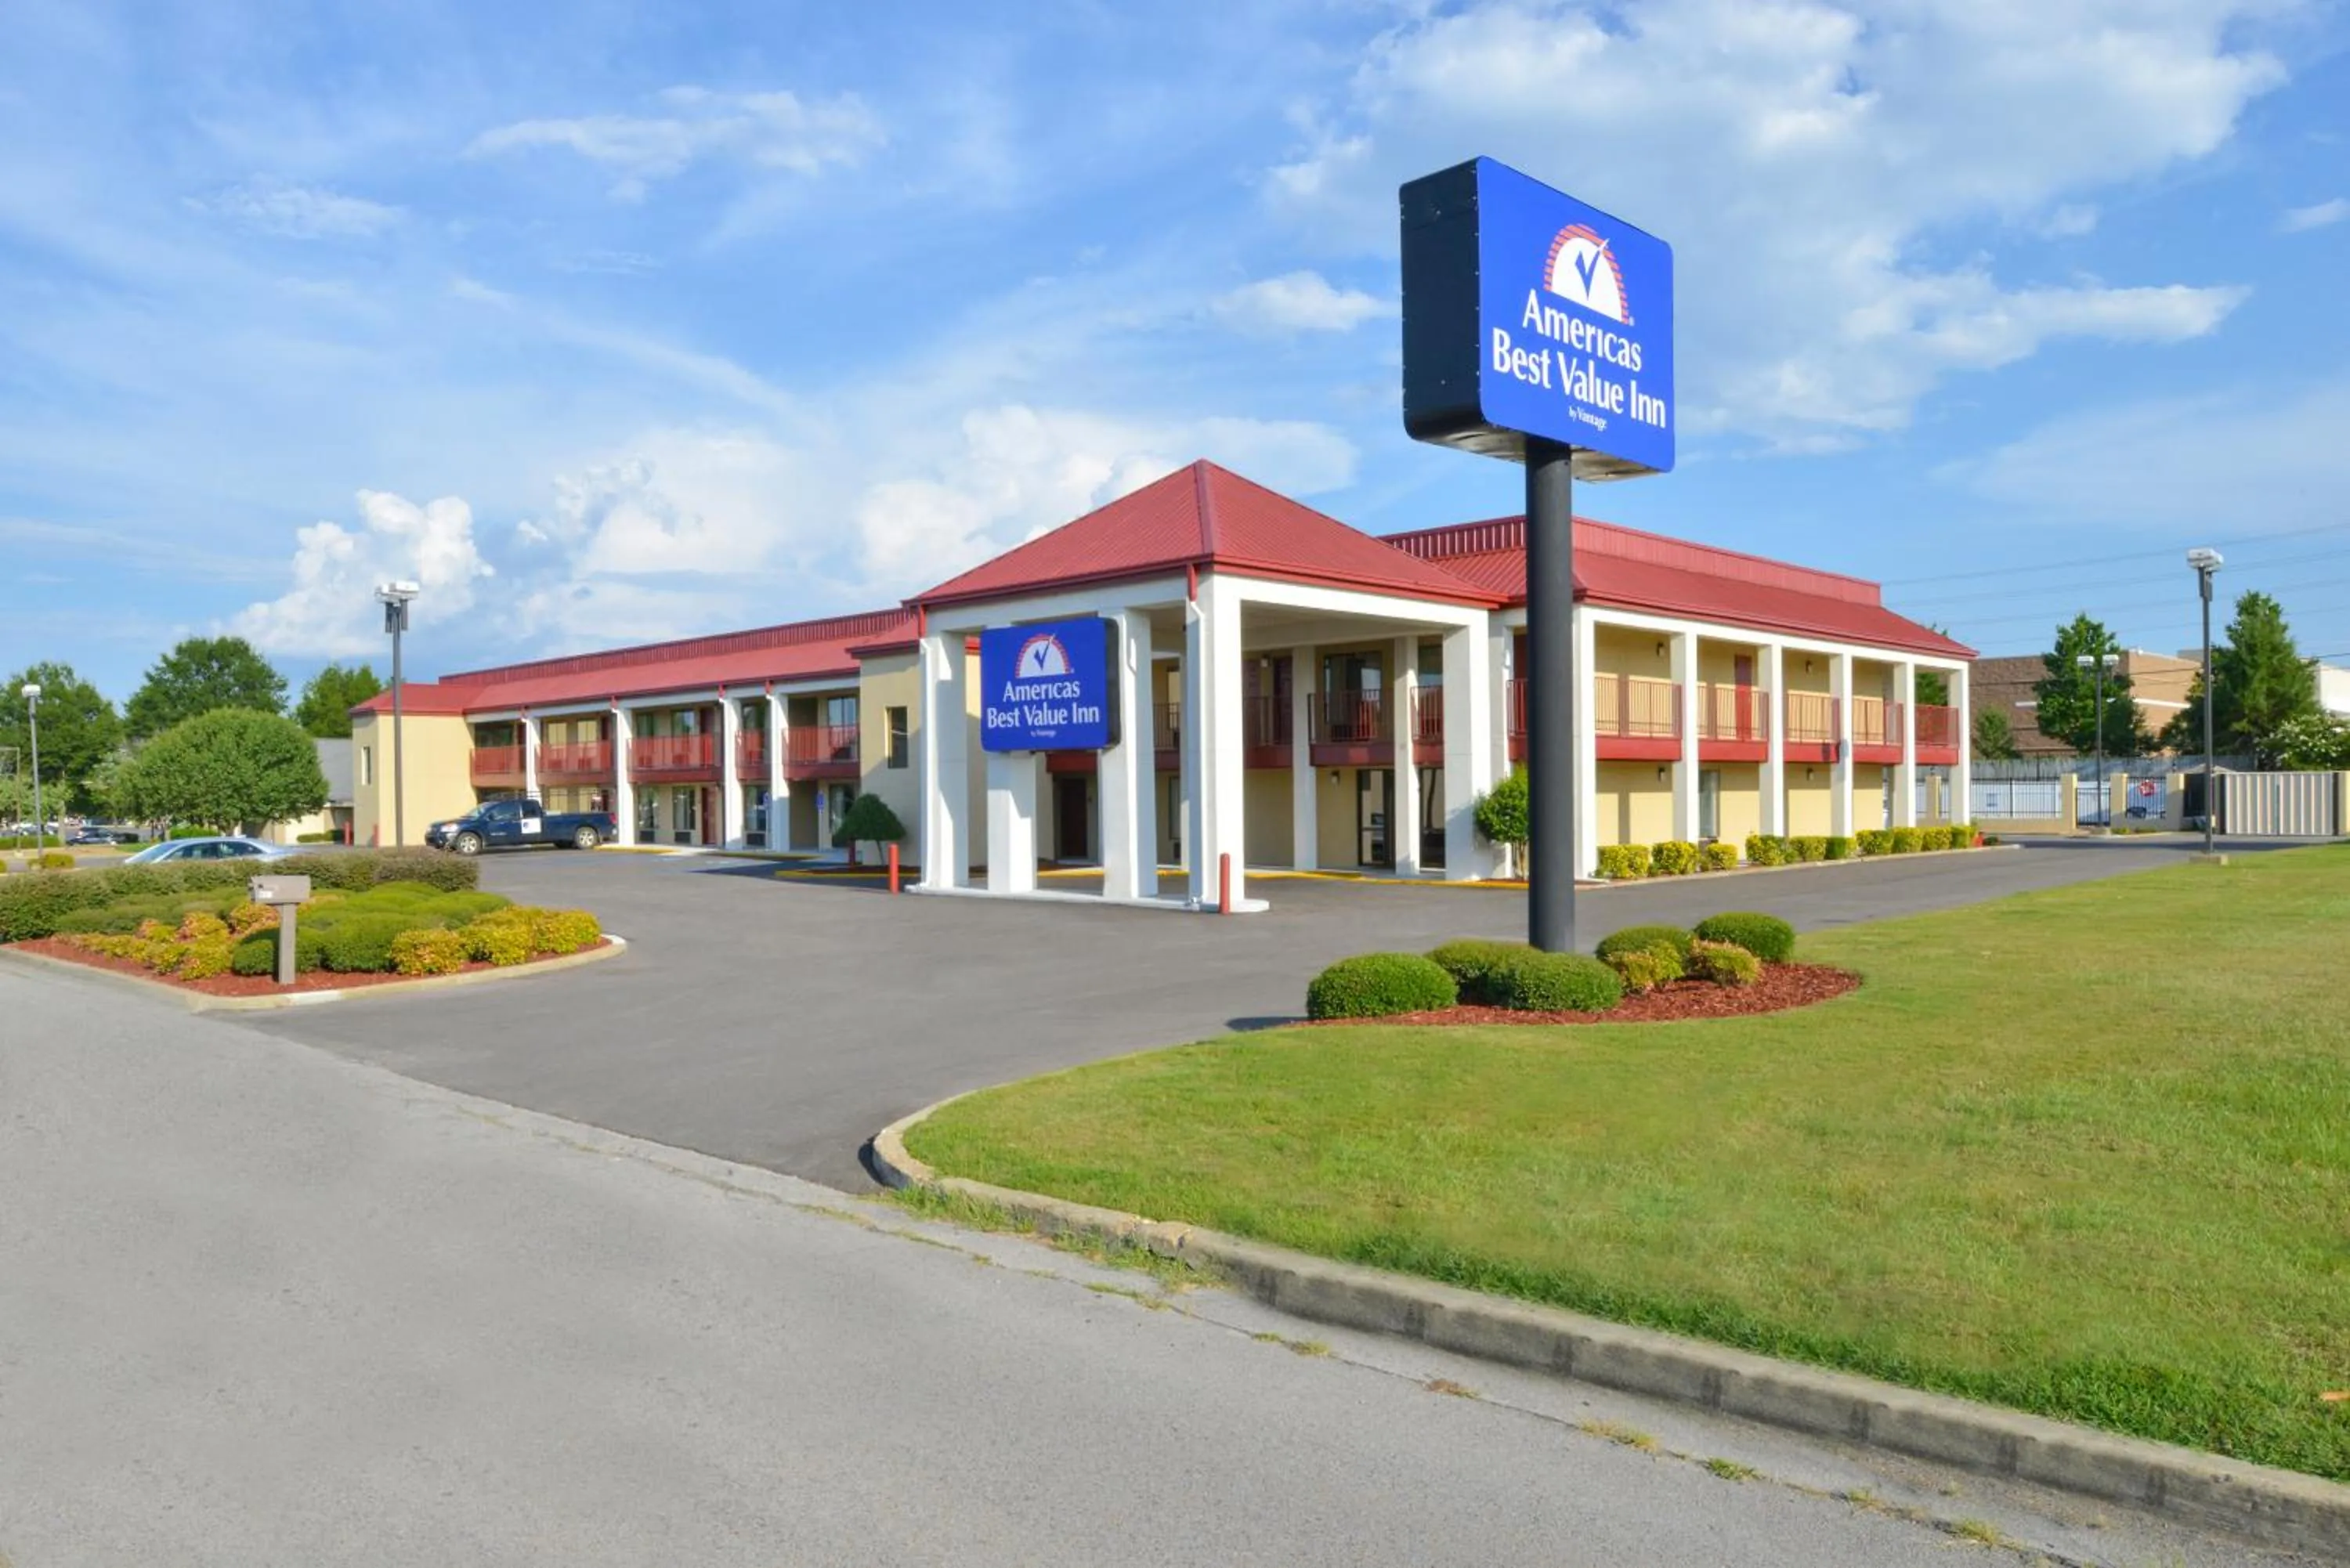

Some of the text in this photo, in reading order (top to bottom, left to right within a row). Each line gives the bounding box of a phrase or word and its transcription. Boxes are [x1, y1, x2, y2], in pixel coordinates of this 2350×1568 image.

[1522, 288, 1642, 372] Americas
[1492, 327, 1666, 428] Best Value Inn
[987, 701, 1100, 729] Best Value Inn
[1002, 680, 1081, 703] Americas
